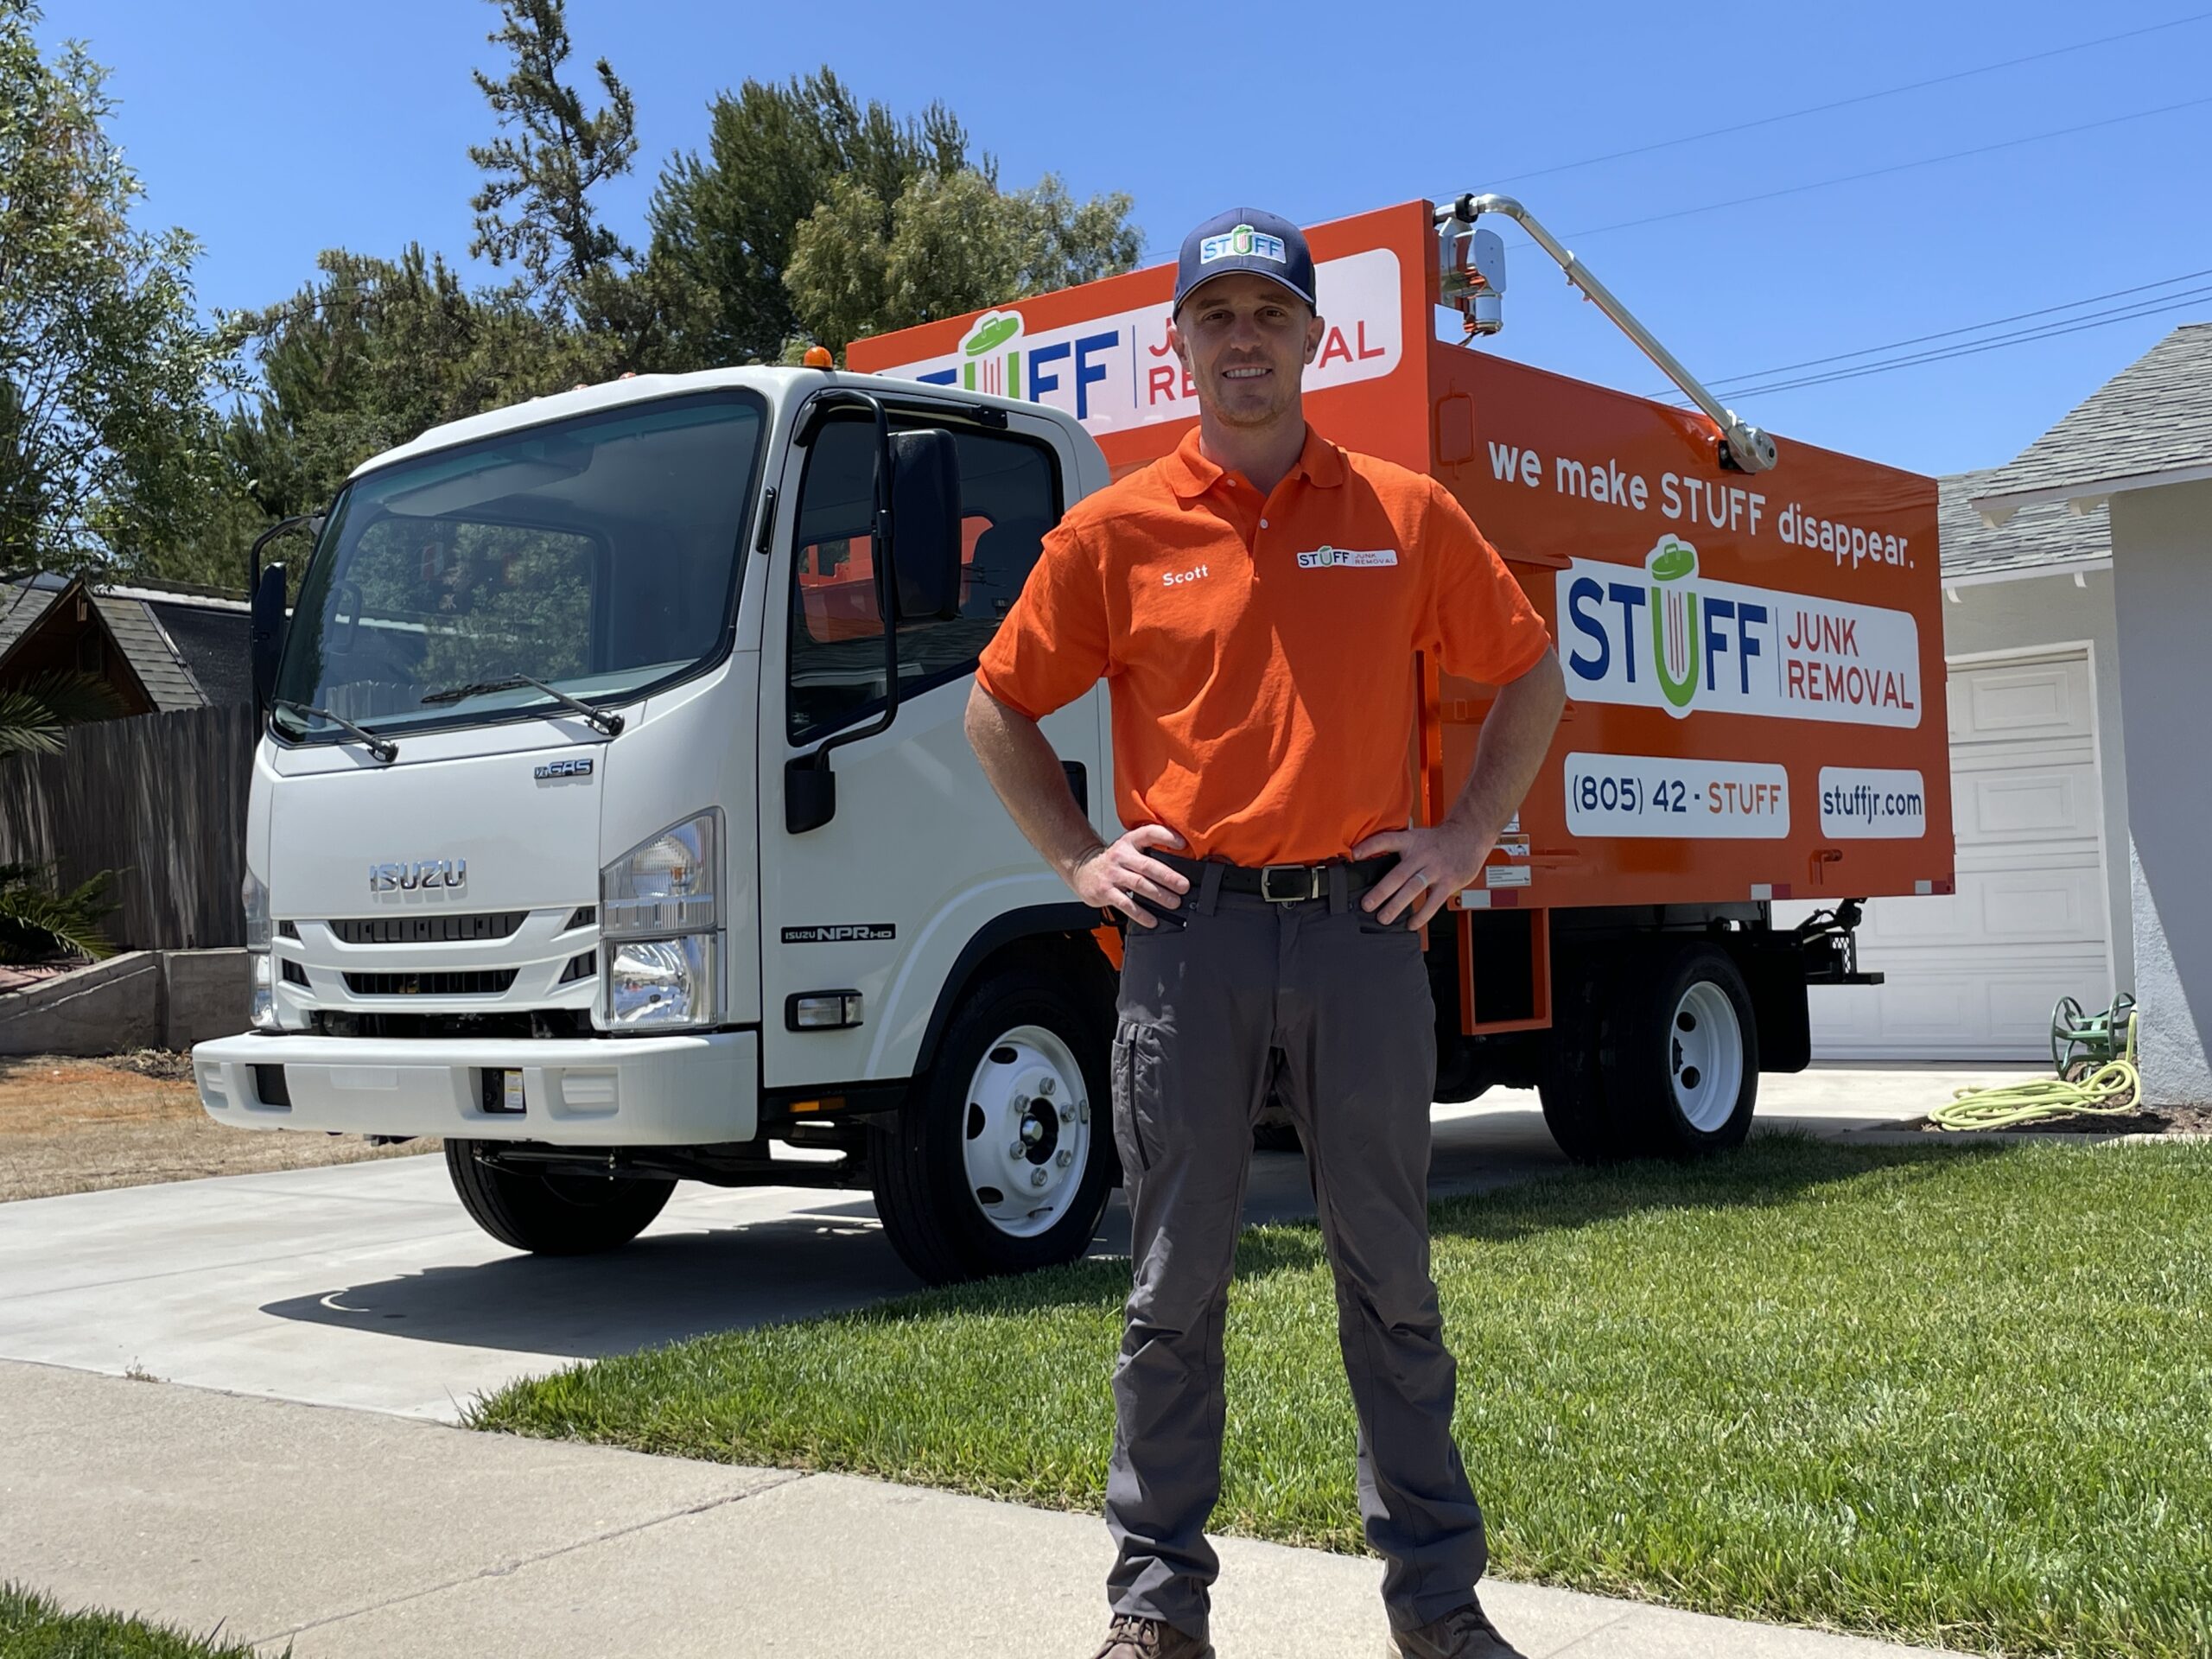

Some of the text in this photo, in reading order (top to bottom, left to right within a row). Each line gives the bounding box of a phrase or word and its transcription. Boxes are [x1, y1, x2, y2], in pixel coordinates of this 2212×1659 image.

[1204, 232, 1281, 259] STUFF
[1488, 442, 1915, 569] we make STUFF disappear.
[1162, 564, 1208, 586] Scott
[1300, 551, 1349, 566] STUFF
[1568, 577, 1768, 708] STUFF
[1787, 612, 1859, 658] JUNK
[1788, 659, 1915, 710] REMOVAL
[548, 760, 591, 776] GAS
[1573, 774, 1643, 815] (805)
[1652, 780, 1687, 813] 42
[1708, 781, 1782, 815] STUFF
[1823, 785, 1923, 824] stuffjr.com
[370, 859, 466, 893] ISUZU
